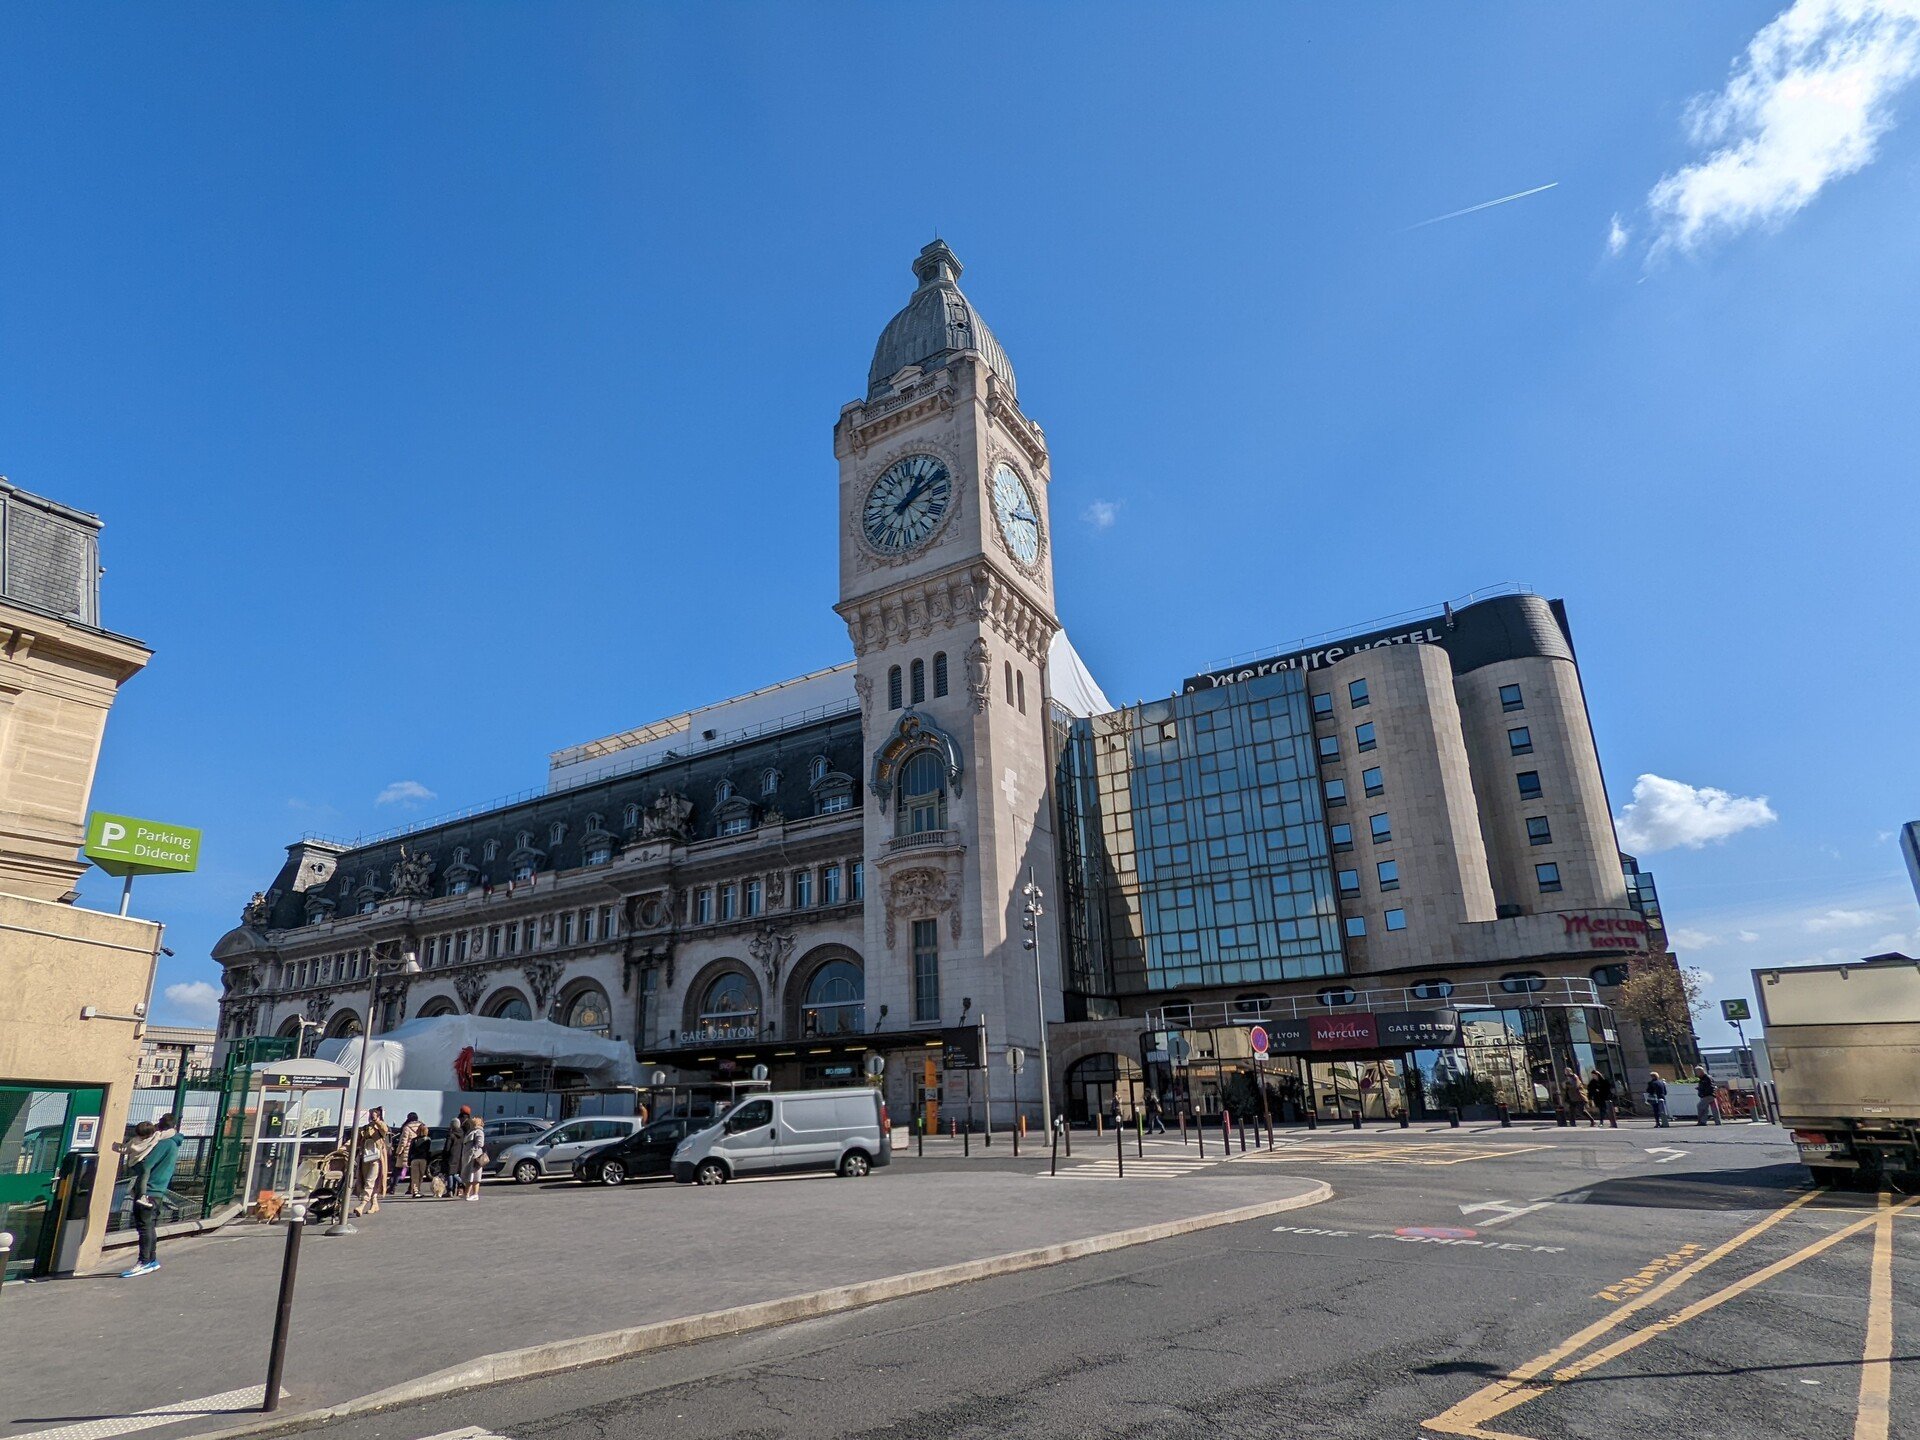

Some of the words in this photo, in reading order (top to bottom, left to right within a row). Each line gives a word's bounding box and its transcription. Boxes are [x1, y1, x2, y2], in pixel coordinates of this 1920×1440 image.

[101, 821, 126, 847] P
[137, 827, 191, 850] Parking
[134, 843, 190, 864] Diderot
[680, 1030, 707, 1042] GARE
[727, 1026, 756, 1039] LYON
[1277, 1031, 1300, 1039] LYON
[1317, 1028, 1369, 1039] Mercure
[1388, 1024, 1415, 1032] GARE
[1419, 1023, 1433, 1031] DE
[1272, 1226, 1358, 1238] VOIE
[1368, 1233, 1566, 1254] POMPIER
